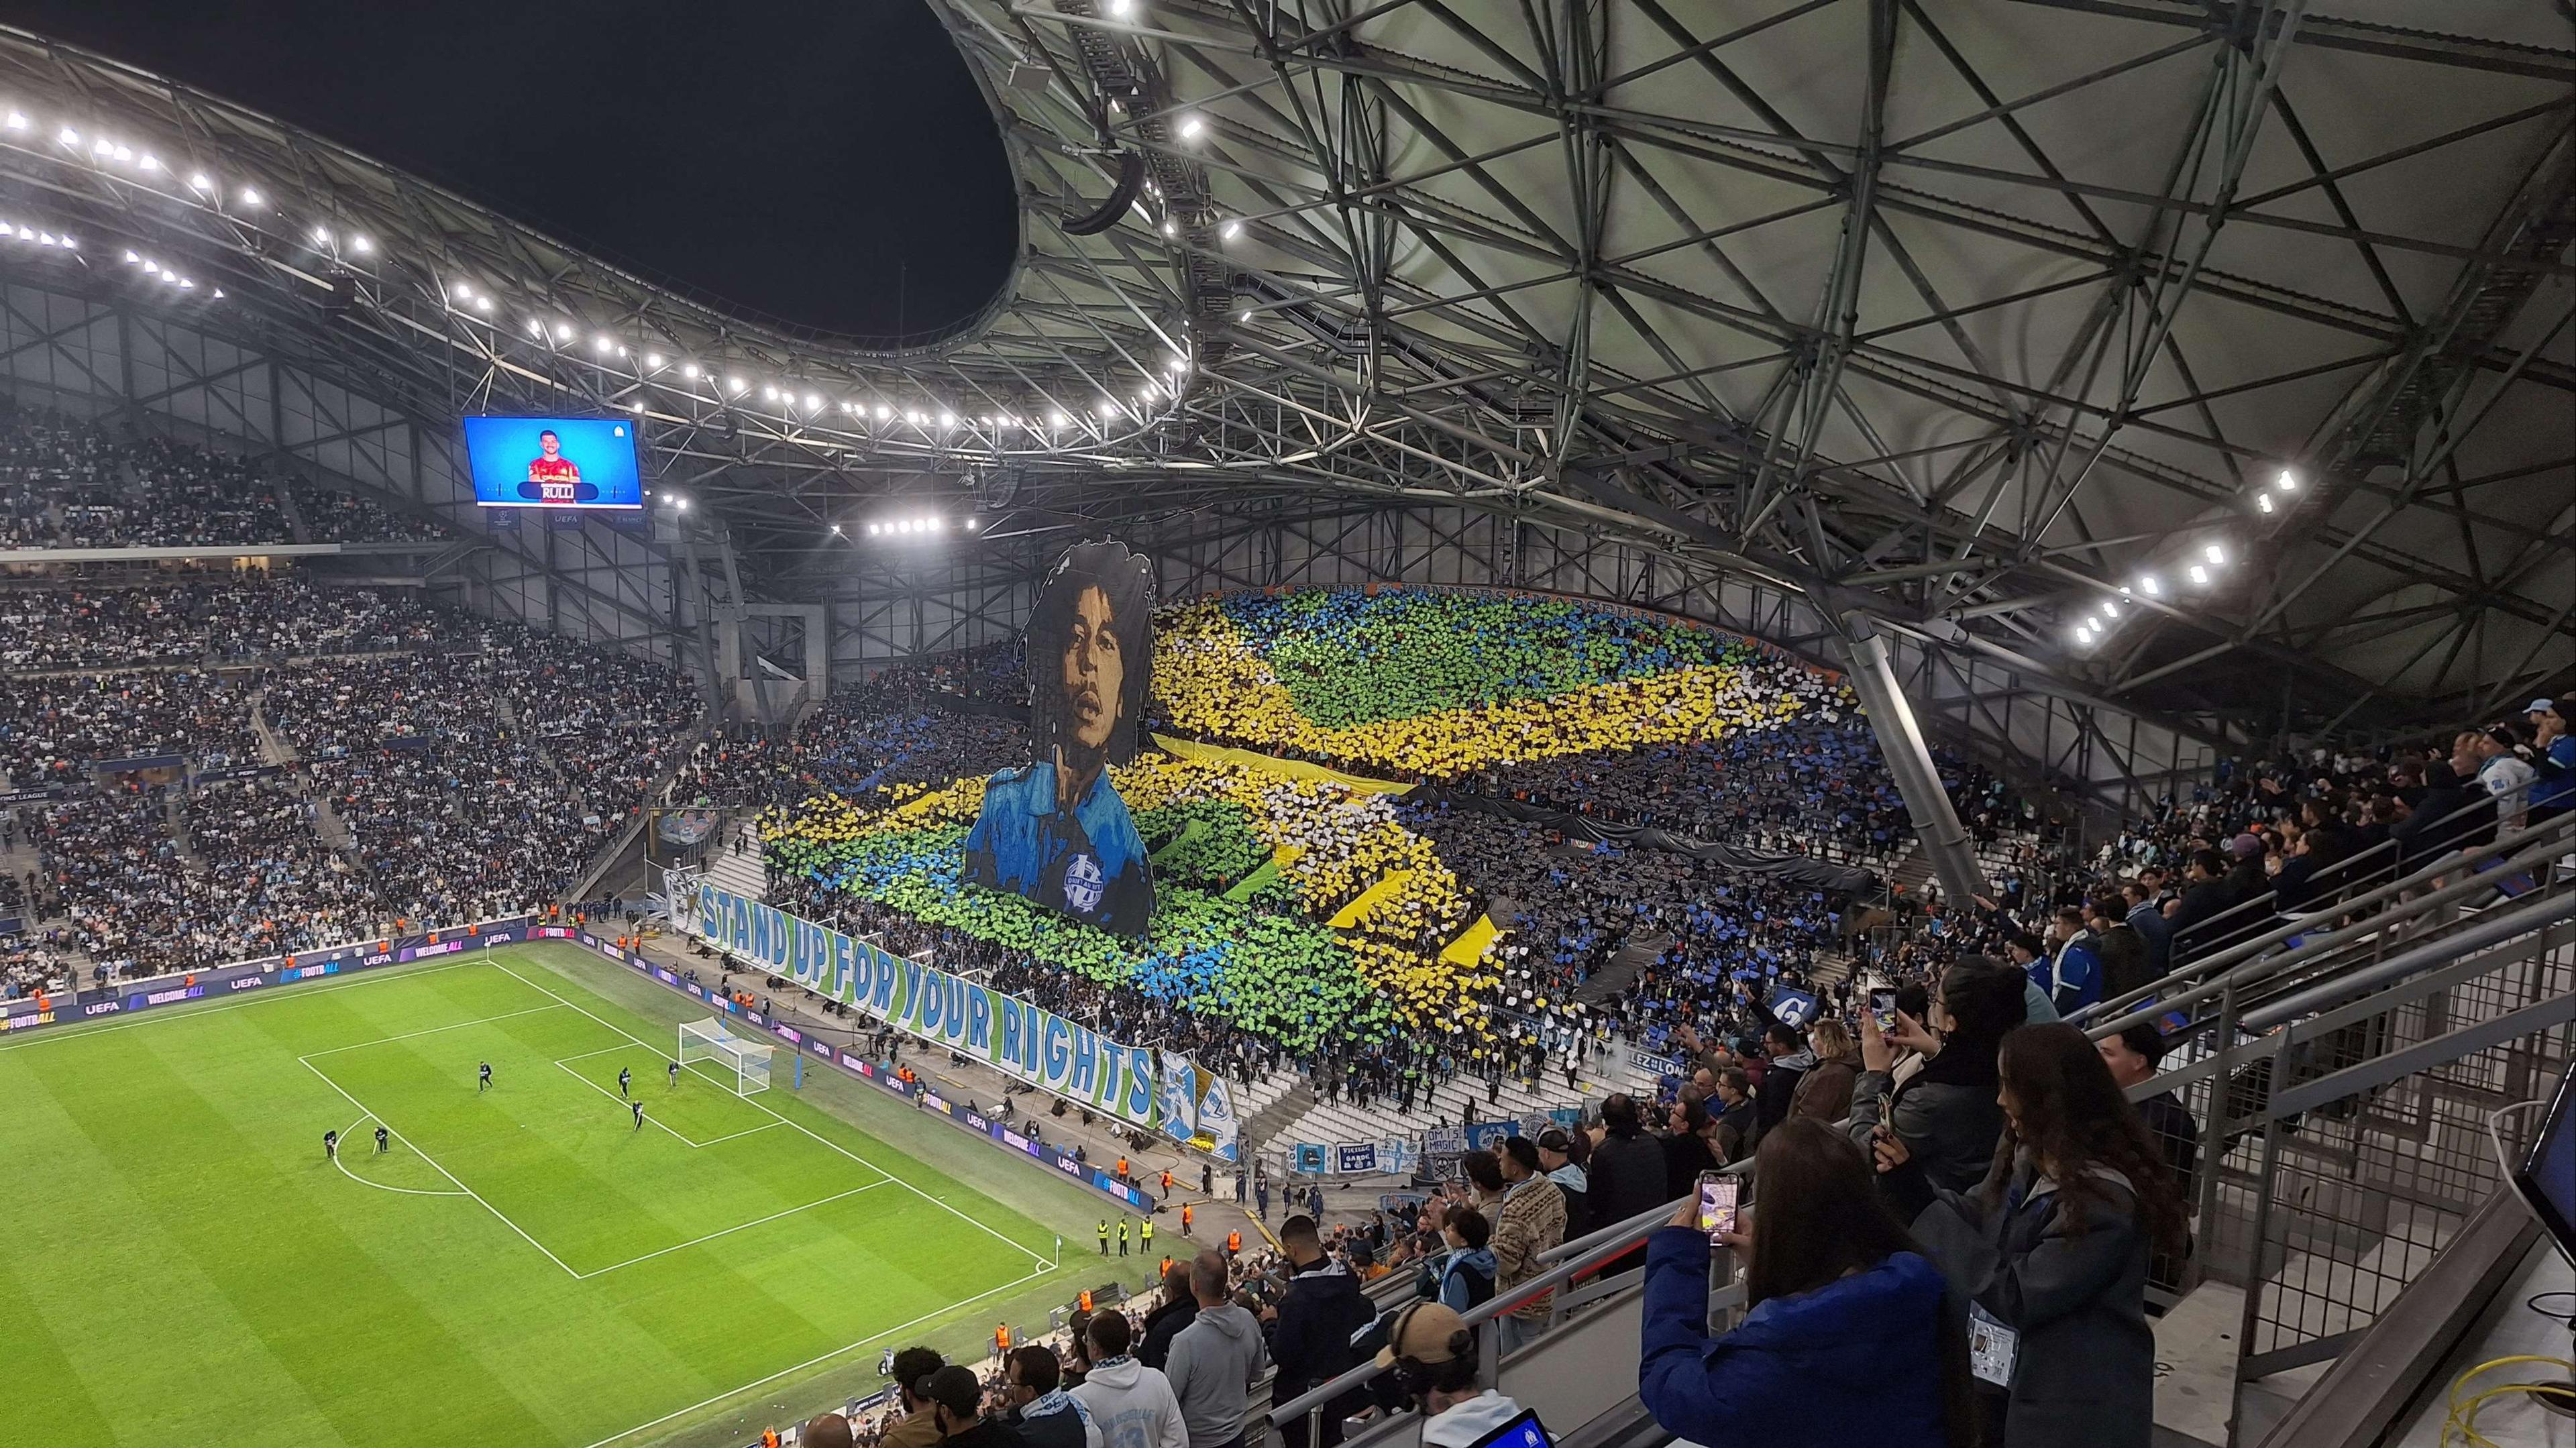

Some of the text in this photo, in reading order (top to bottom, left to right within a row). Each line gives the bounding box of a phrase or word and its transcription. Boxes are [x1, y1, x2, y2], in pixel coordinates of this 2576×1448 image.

[543, 488, 574, 499] RULLI
[555, 514, 578, 523] UEFA
[19, 792, 48, 800] LEAGUE
[484, 933, 511, 944] UEFA
[538, 927, 575, 938] #FOOTBALL
[583, 935, 596, 947] UEFA
[364, 954, 392, 966] UEFA
[634, 957, 646, 970] UEFA
[293, 962, 339, 979] #FOOTBALL
[231, 977, 262, 989] UEFA
[688, 982, 702, 997] UEFA
[700, 883, 1151, 1115] STAND UP FOR YOUR RIGHTS
[85, 1001, 120, 1015] UEFA
[0, 1011, 56, 1031] #FOOTBALL
[747, 1010, 763, 1025] UEFA
[814, 1041, 830, 1057] UEFA
[886, 1074, 904, 1093] UEFA
[922, 1091, 951, 1115] #FOOTBALL
[967, 1113, 987, 1132] UEFA
[1428, 1130, 1443, 1141] OM
[1430, 1140, 1457, 1151] MAGIC
[1057, 1156, 1081, 1176] UEFA
[1103, 1177, 1140, 1206] #FOOTBALL
